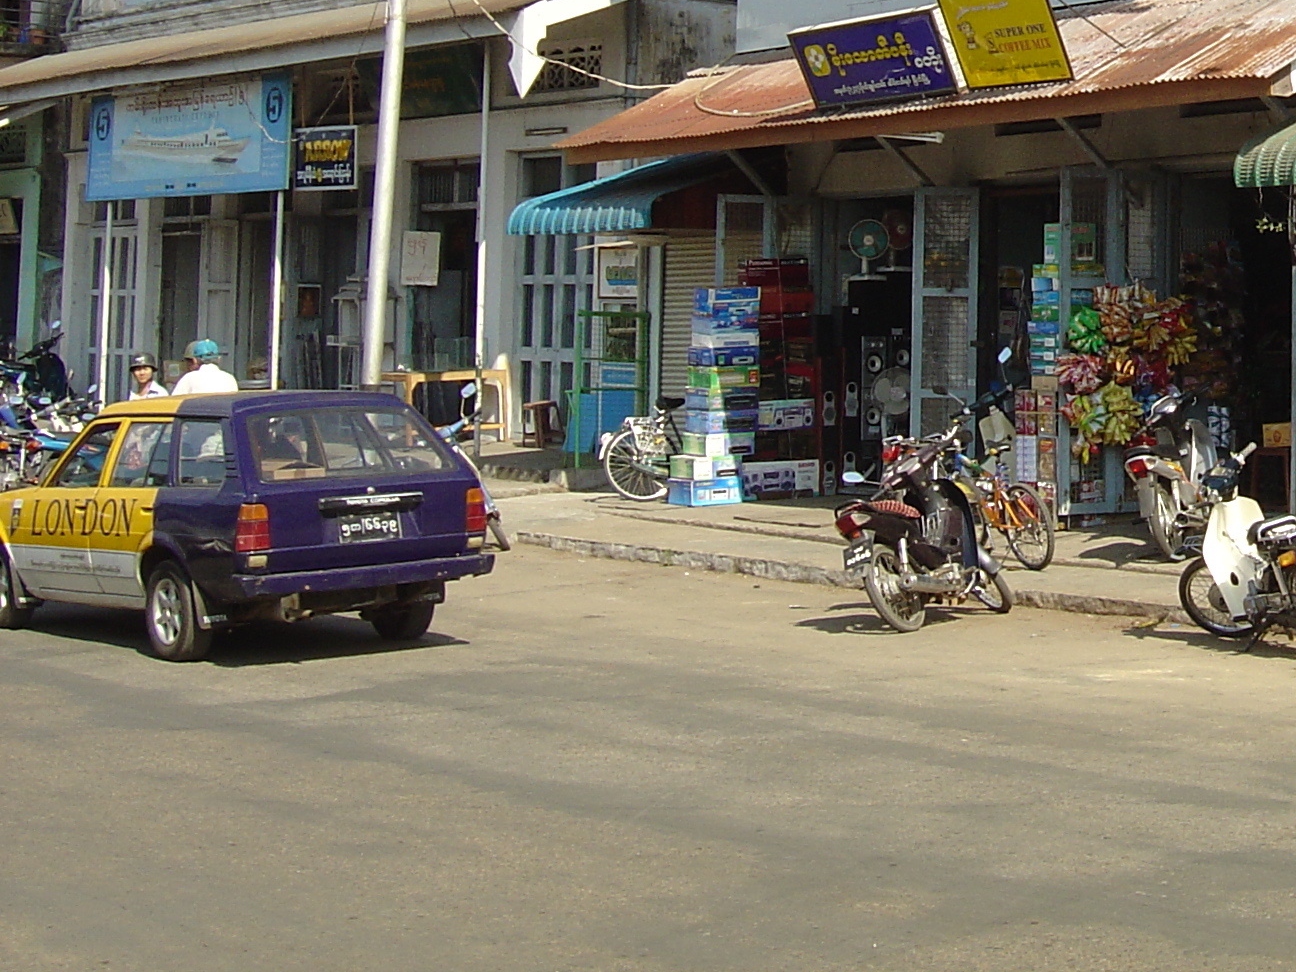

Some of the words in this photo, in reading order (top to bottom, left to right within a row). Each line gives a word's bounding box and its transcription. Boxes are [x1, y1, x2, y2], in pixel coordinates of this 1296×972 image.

[994, 25, 1025, 38] SUPER
[1025, 23, 1047, 34] ONE
[998, 38, 1032, 53] COFFEE
[1032, 37, 1052, 49] MIX
[31, 498, 138, 537] LONDON
